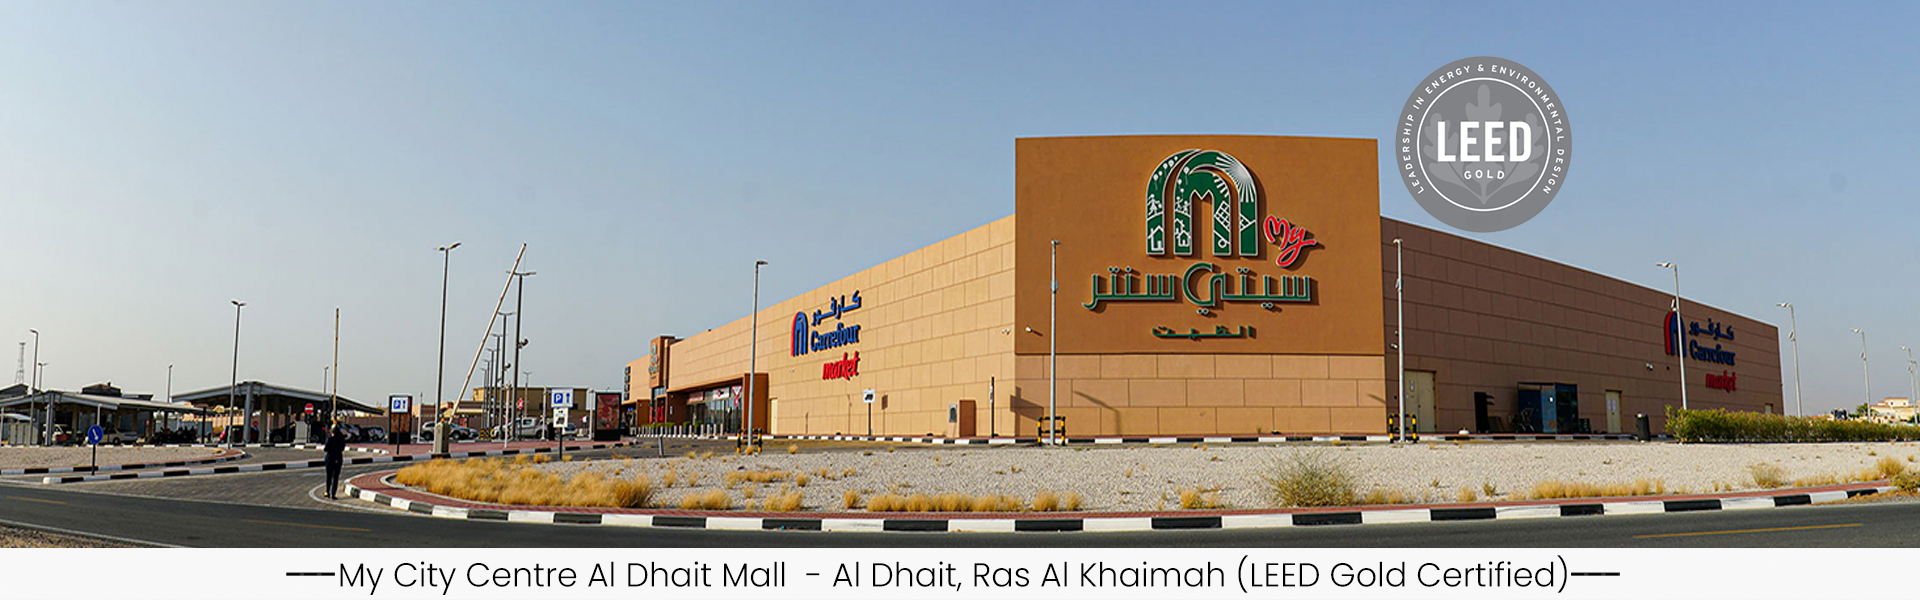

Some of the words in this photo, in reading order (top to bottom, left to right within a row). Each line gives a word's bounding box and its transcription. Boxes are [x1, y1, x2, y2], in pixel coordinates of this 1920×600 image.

[1263, 214, 1316, 267] My
[1081, 266, 1175, 310] سنتر
[1182, 262, 1311, 315] سيتي
[810, 322, 861, 352] Carrefour
[822, 351, 860, 381] market
[1690, 339, 1736, 366] Carrefour
[1706, 370, 1737, 393] market
